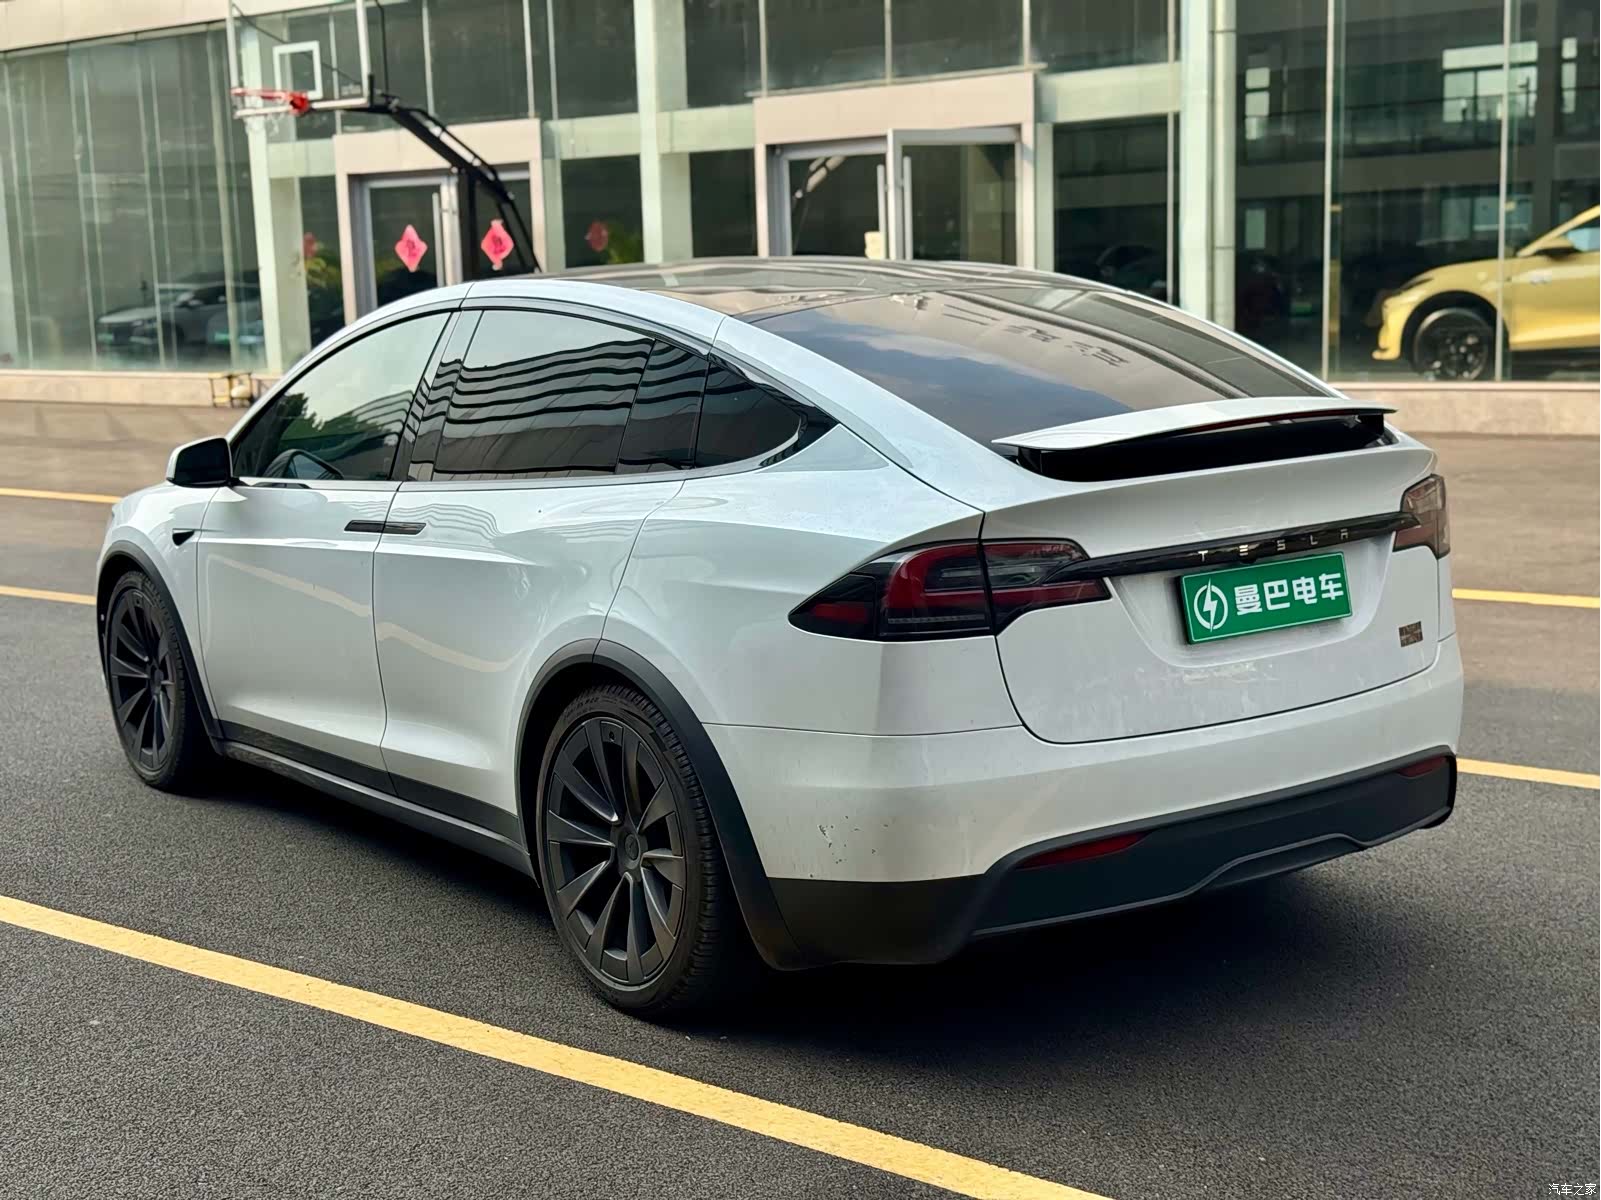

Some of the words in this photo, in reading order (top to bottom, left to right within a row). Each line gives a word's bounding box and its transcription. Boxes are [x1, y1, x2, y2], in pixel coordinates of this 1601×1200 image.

[1198, 528, 1349, 562] TESLA
[1234, 572, 1344, 616] 曼巴电车
